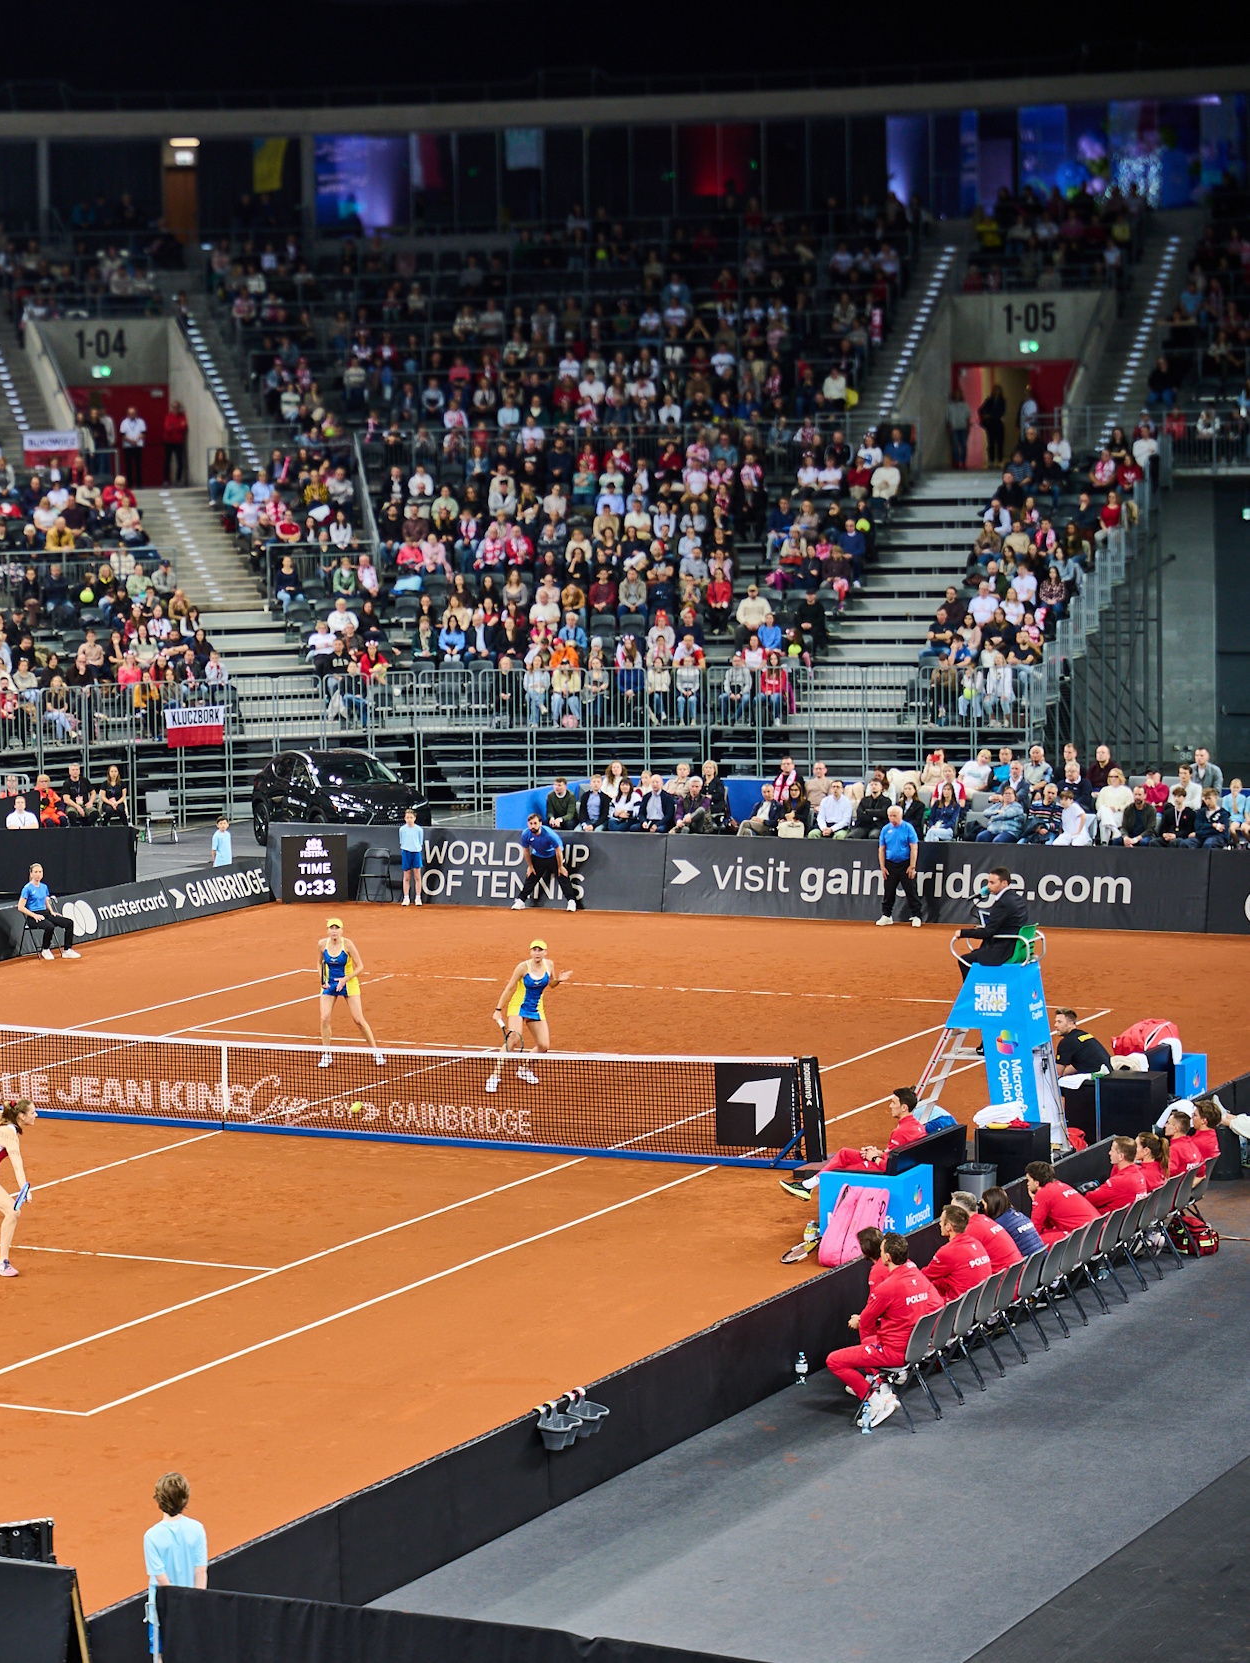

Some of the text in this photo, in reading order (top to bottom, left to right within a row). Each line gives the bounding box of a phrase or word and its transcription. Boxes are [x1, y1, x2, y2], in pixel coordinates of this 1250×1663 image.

[1003, 302, 1056, 334] 1-05
[74, 328, 128, 359] 1-04
[171, 708, 220, 726] KLUCZBORK
[424, 839, 524, 867] WORLD
[298, 862, 332, 875] TIME
[422, 869, 464, 897] OF
[712, 856, 791, 893] visit
[185, 868, 270, 909] GAINBRIDGE
[294, 879, 337, 896] 0:33
[97, 890, 169, 921] mastercard
[974, 985, 1007, 995] BILLIE
[974, 1002, 1007, 1012] KING
[803, 1062, 812, 1100] GAINBRIDGE
[998, 1060, 1013, 1102] Copilot
[57, 1076, 152, 1109] JEAN
[159, 1080, 251, 1114] KING
[388, 1101, 533, 1135] GAINBRIDGE
[906, 1203, 931, 1230] Microsoft
